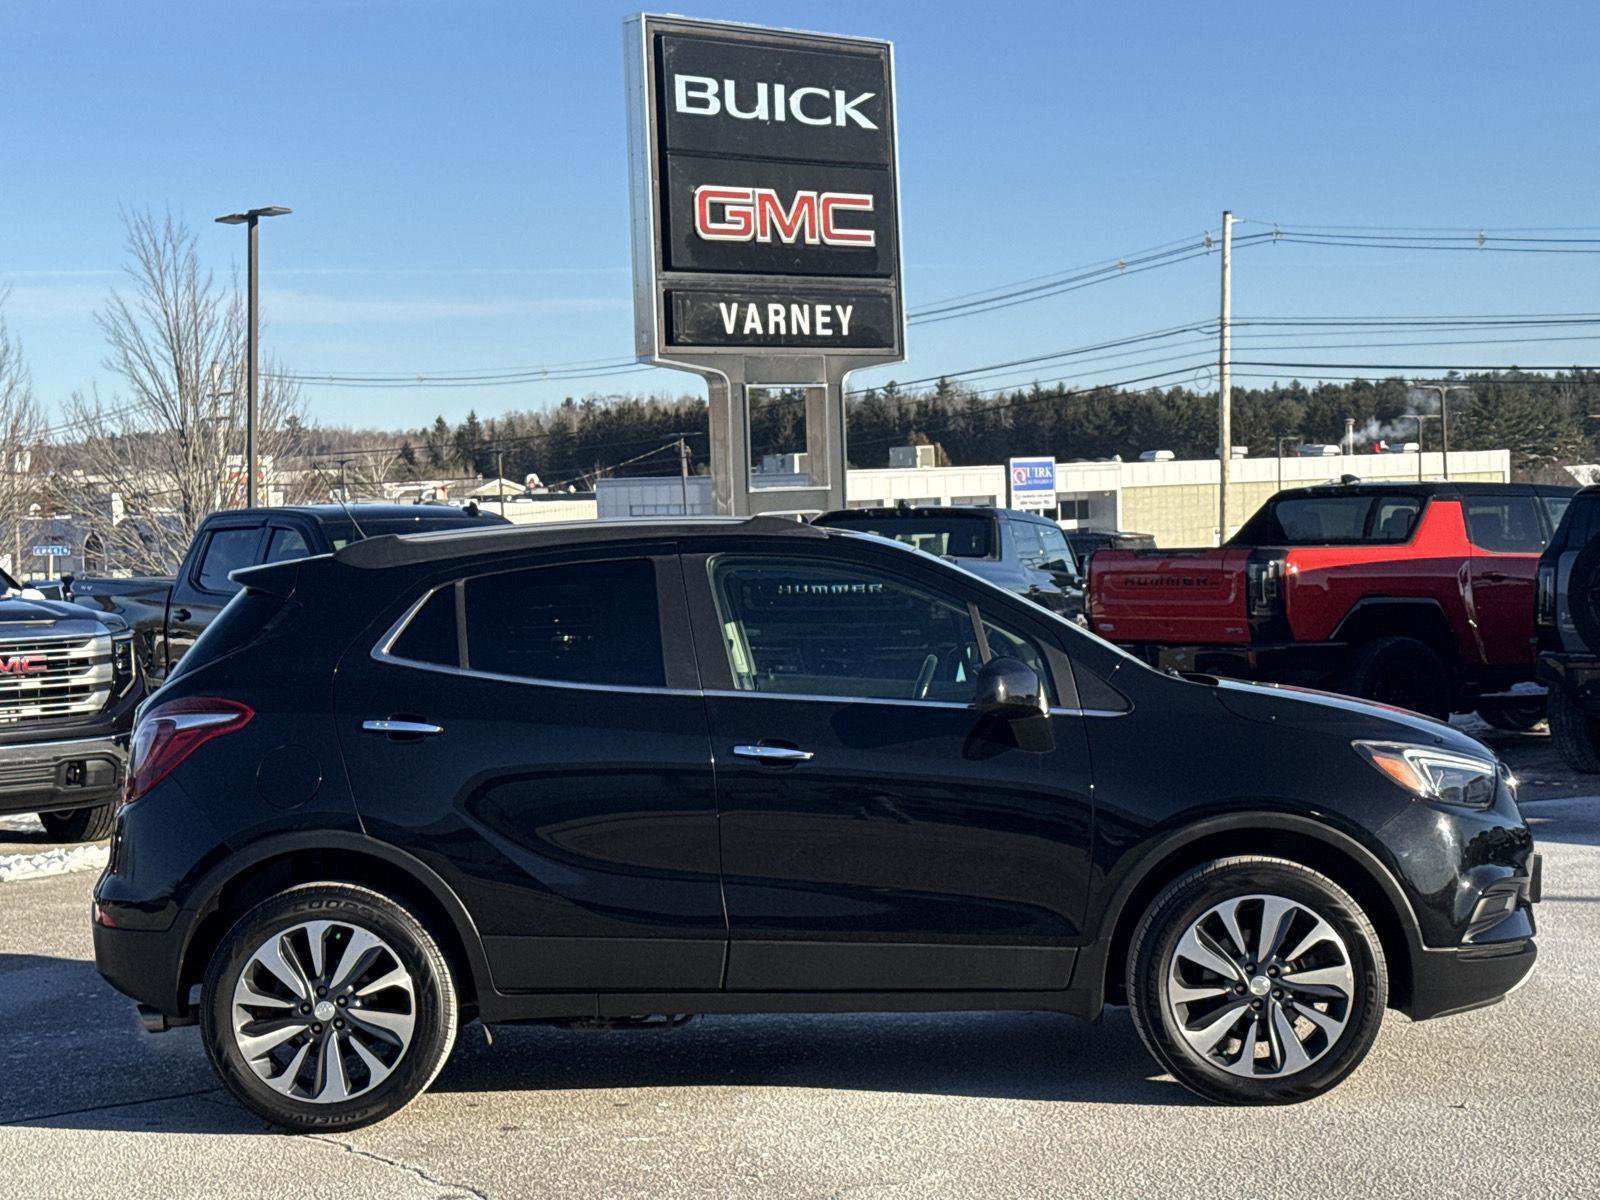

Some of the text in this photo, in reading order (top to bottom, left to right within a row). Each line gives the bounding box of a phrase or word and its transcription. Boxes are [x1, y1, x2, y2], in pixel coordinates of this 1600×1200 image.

[674, 74, 879, 130] BUICK
[694, 184, 876, 247] GMC
[719, 302, 853, 336] VARNEY
[0, 655, 48, 672] MC
